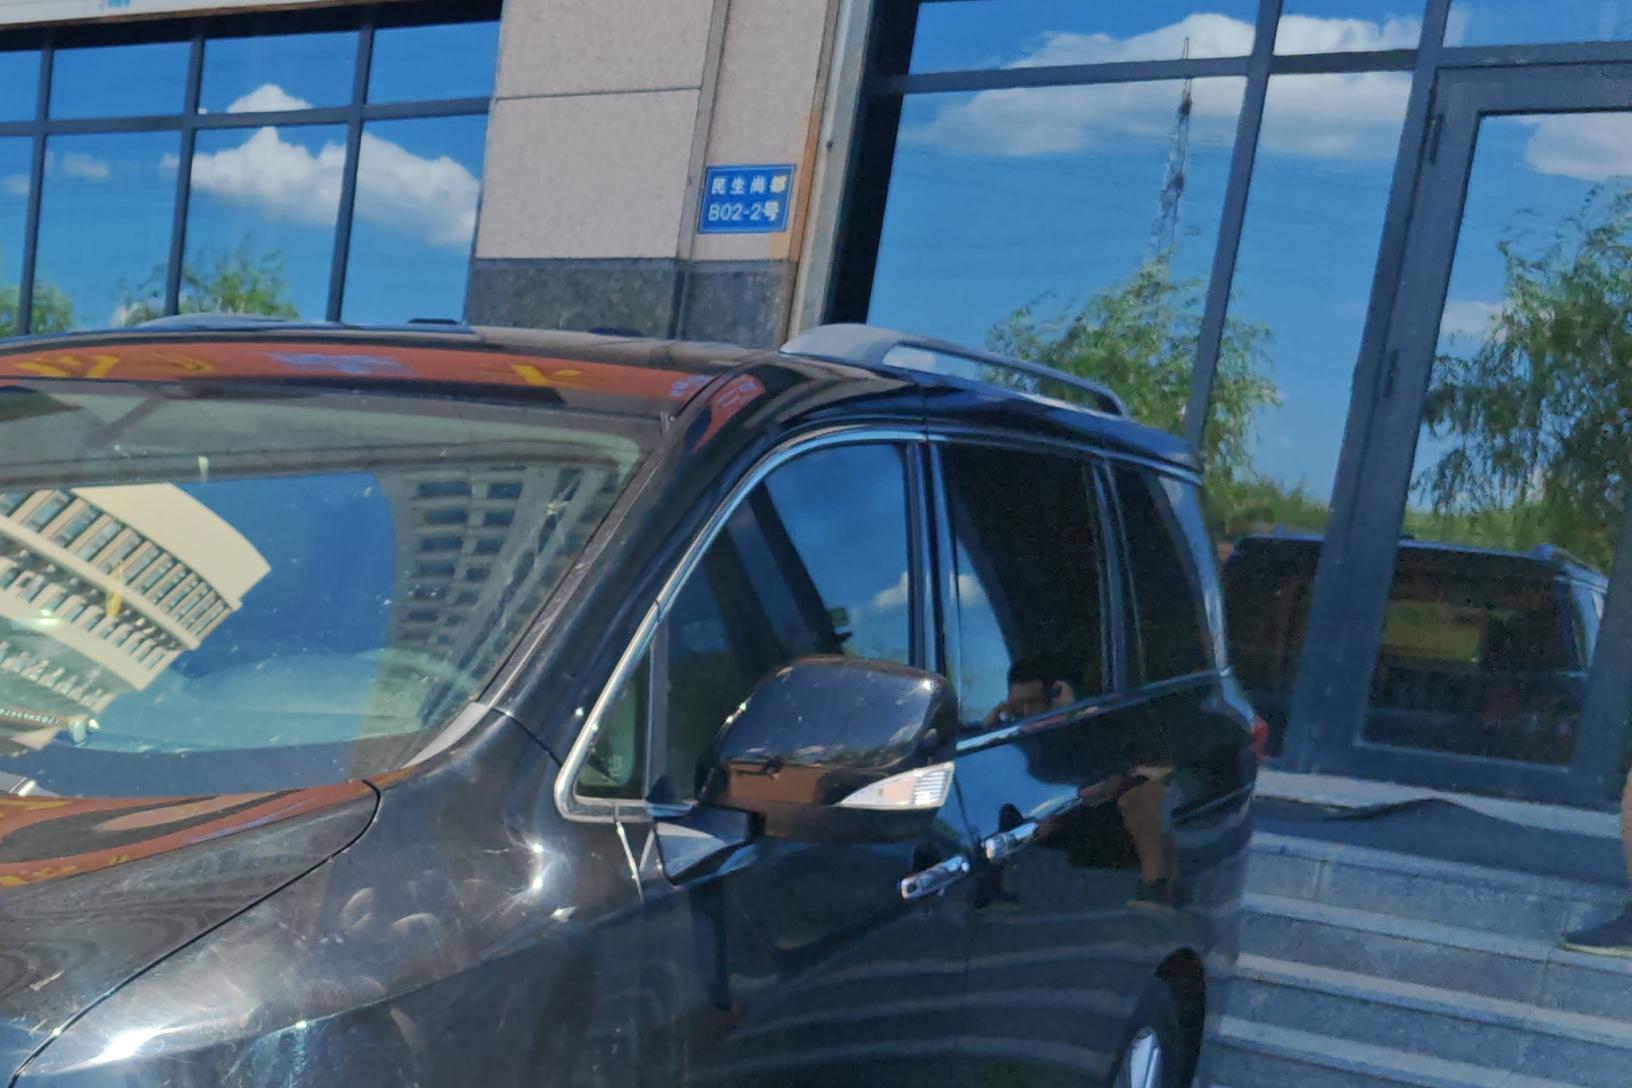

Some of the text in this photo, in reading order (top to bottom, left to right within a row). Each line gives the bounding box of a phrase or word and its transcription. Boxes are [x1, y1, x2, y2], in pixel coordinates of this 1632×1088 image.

[712, 176, 787, 194] 民生尚都
[708, 201, 779, 221] B02-2号
